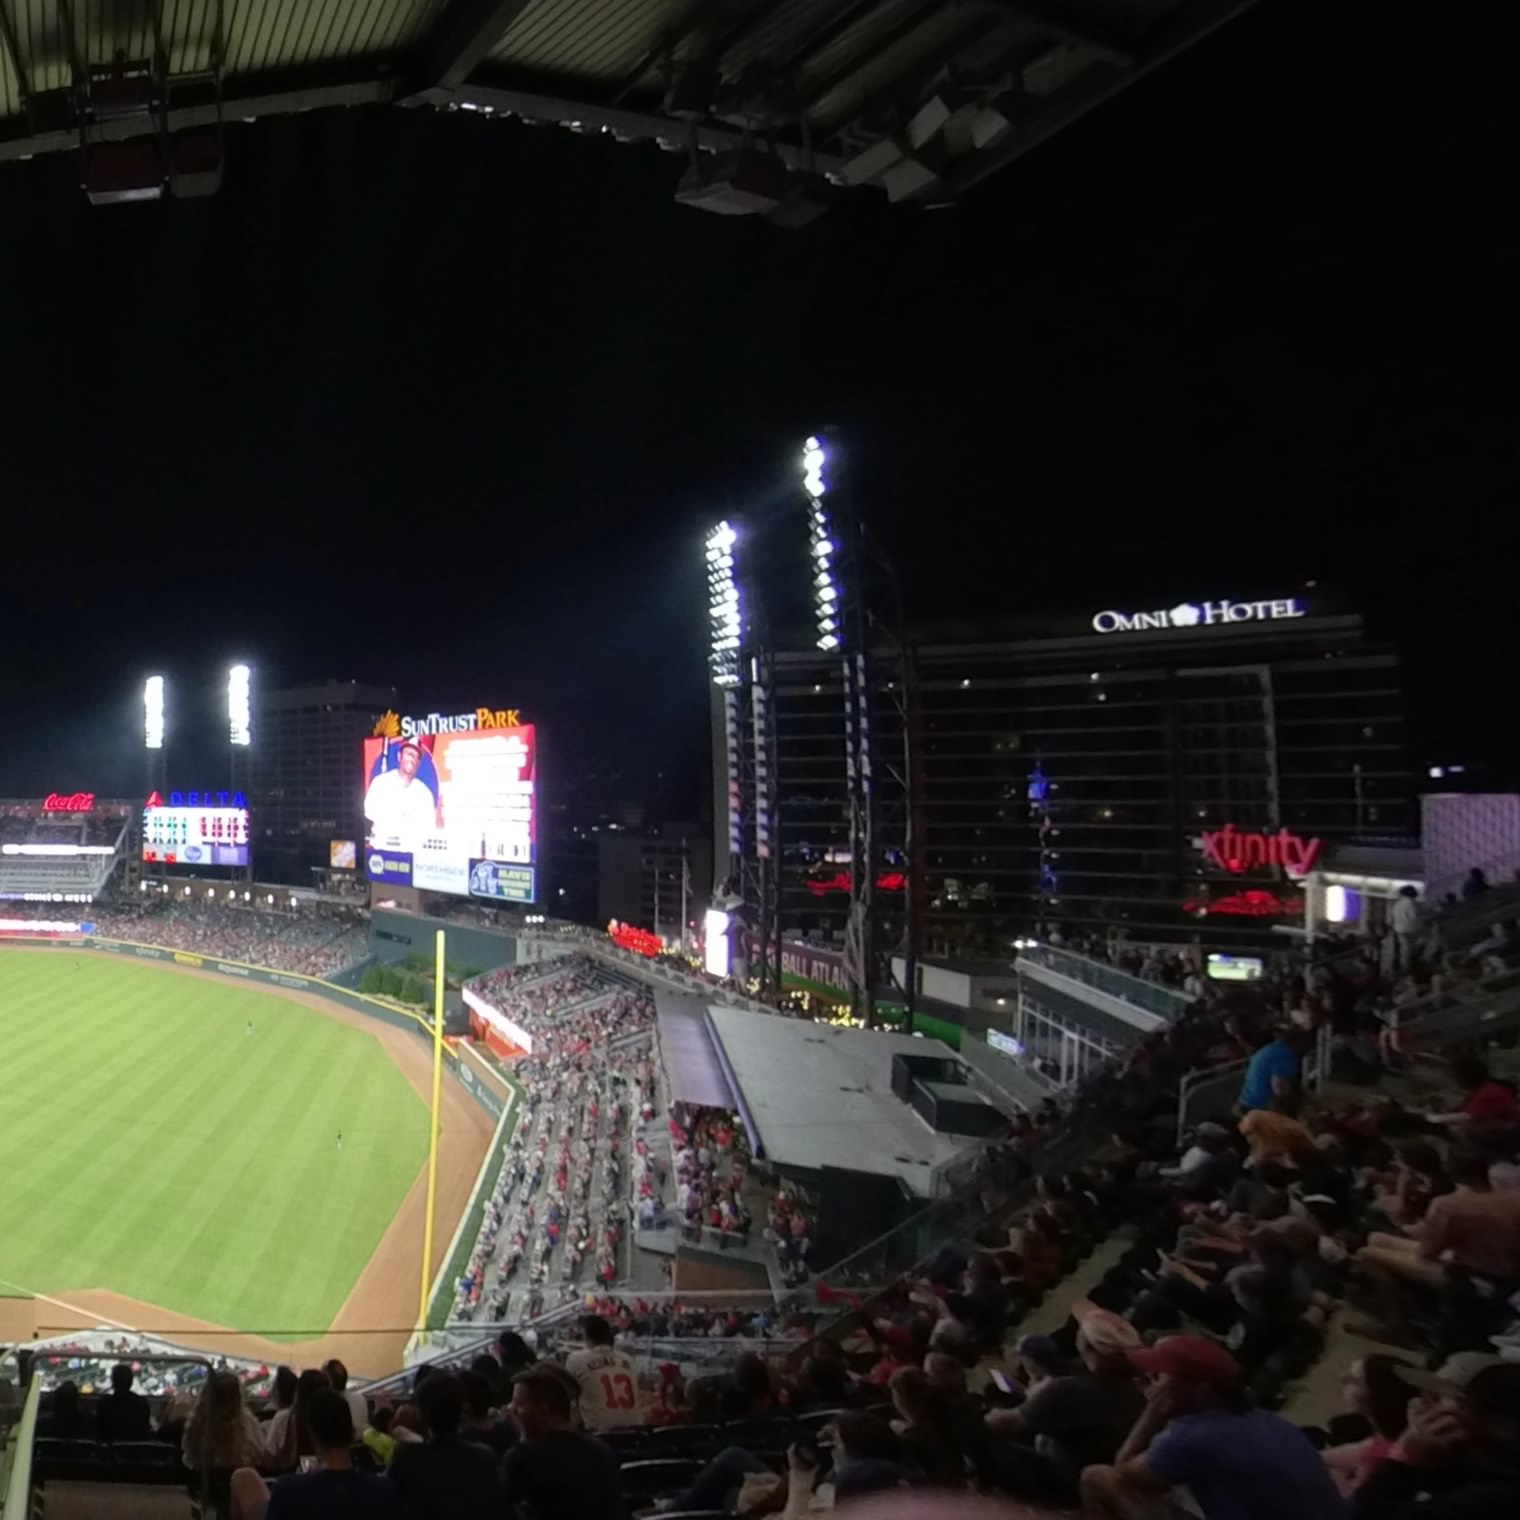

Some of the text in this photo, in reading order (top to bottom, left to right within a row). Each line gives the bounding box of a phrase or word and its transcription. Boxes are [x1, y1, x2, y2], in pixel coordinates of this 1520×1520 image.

[1092, 599, 1306, 633] OMNI HOTEL
[170, 791, 248, 808] DELTA
[1200, 823, 1320, 874] xfinity
[811, 960, 848, 991] ATLAN
[601, 1374, 635, 1409] 13
